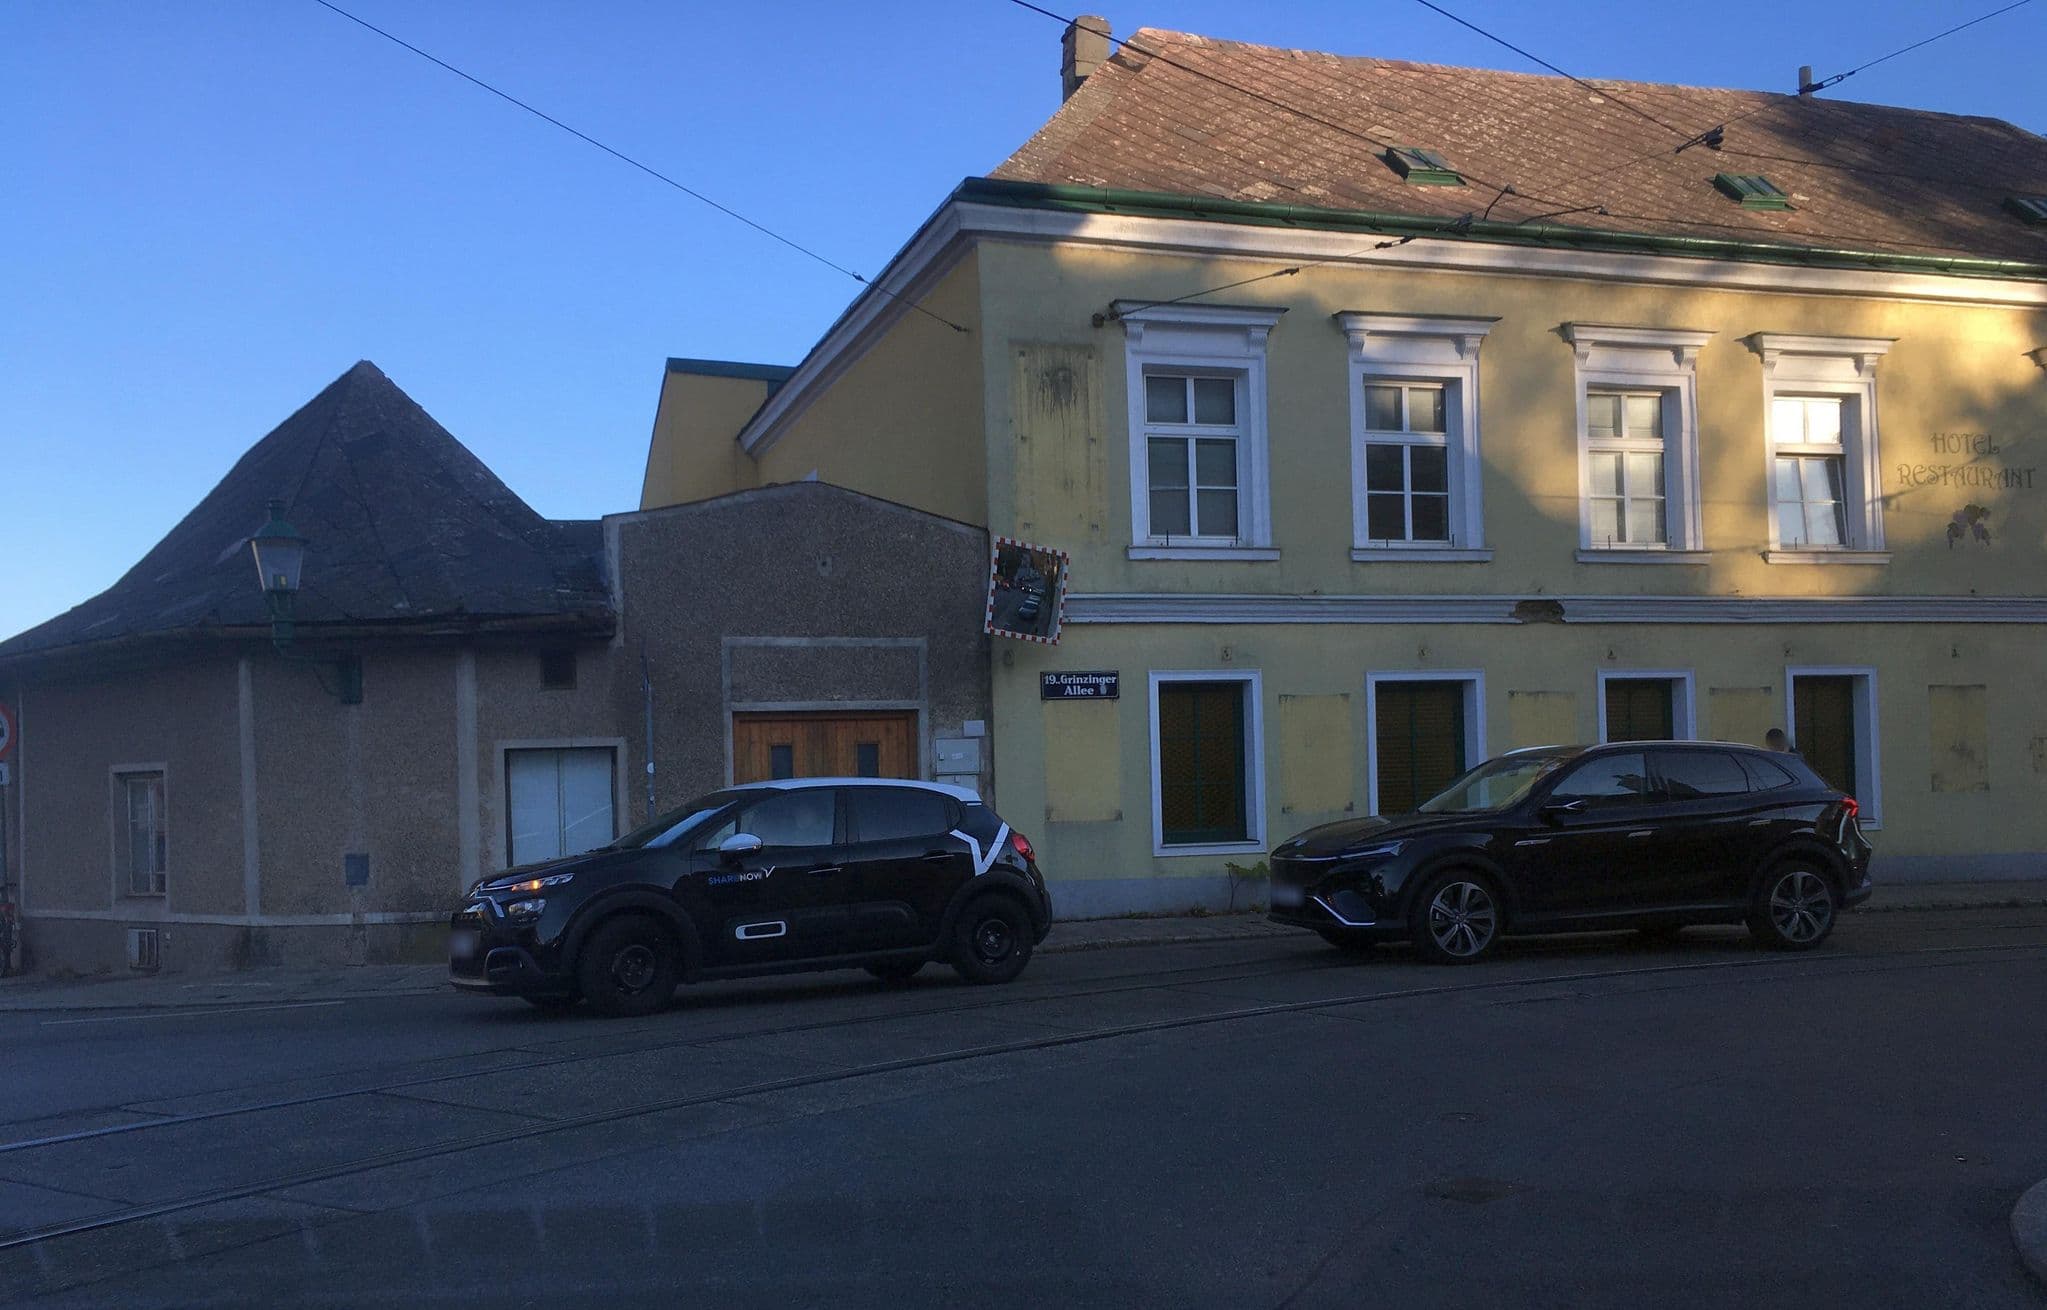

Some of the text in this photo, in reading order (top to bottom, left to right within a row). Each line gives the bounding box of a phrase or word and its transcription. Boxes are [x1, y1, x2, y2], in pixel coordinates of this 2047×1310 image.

[1930, 432, 2000, 455] HOTEL
[1897, 463, 2036, 489] RESTAURANT
[1060, 674, 1116, 686] Grinzinger
[1064, 685, 1094, 696] Allee
